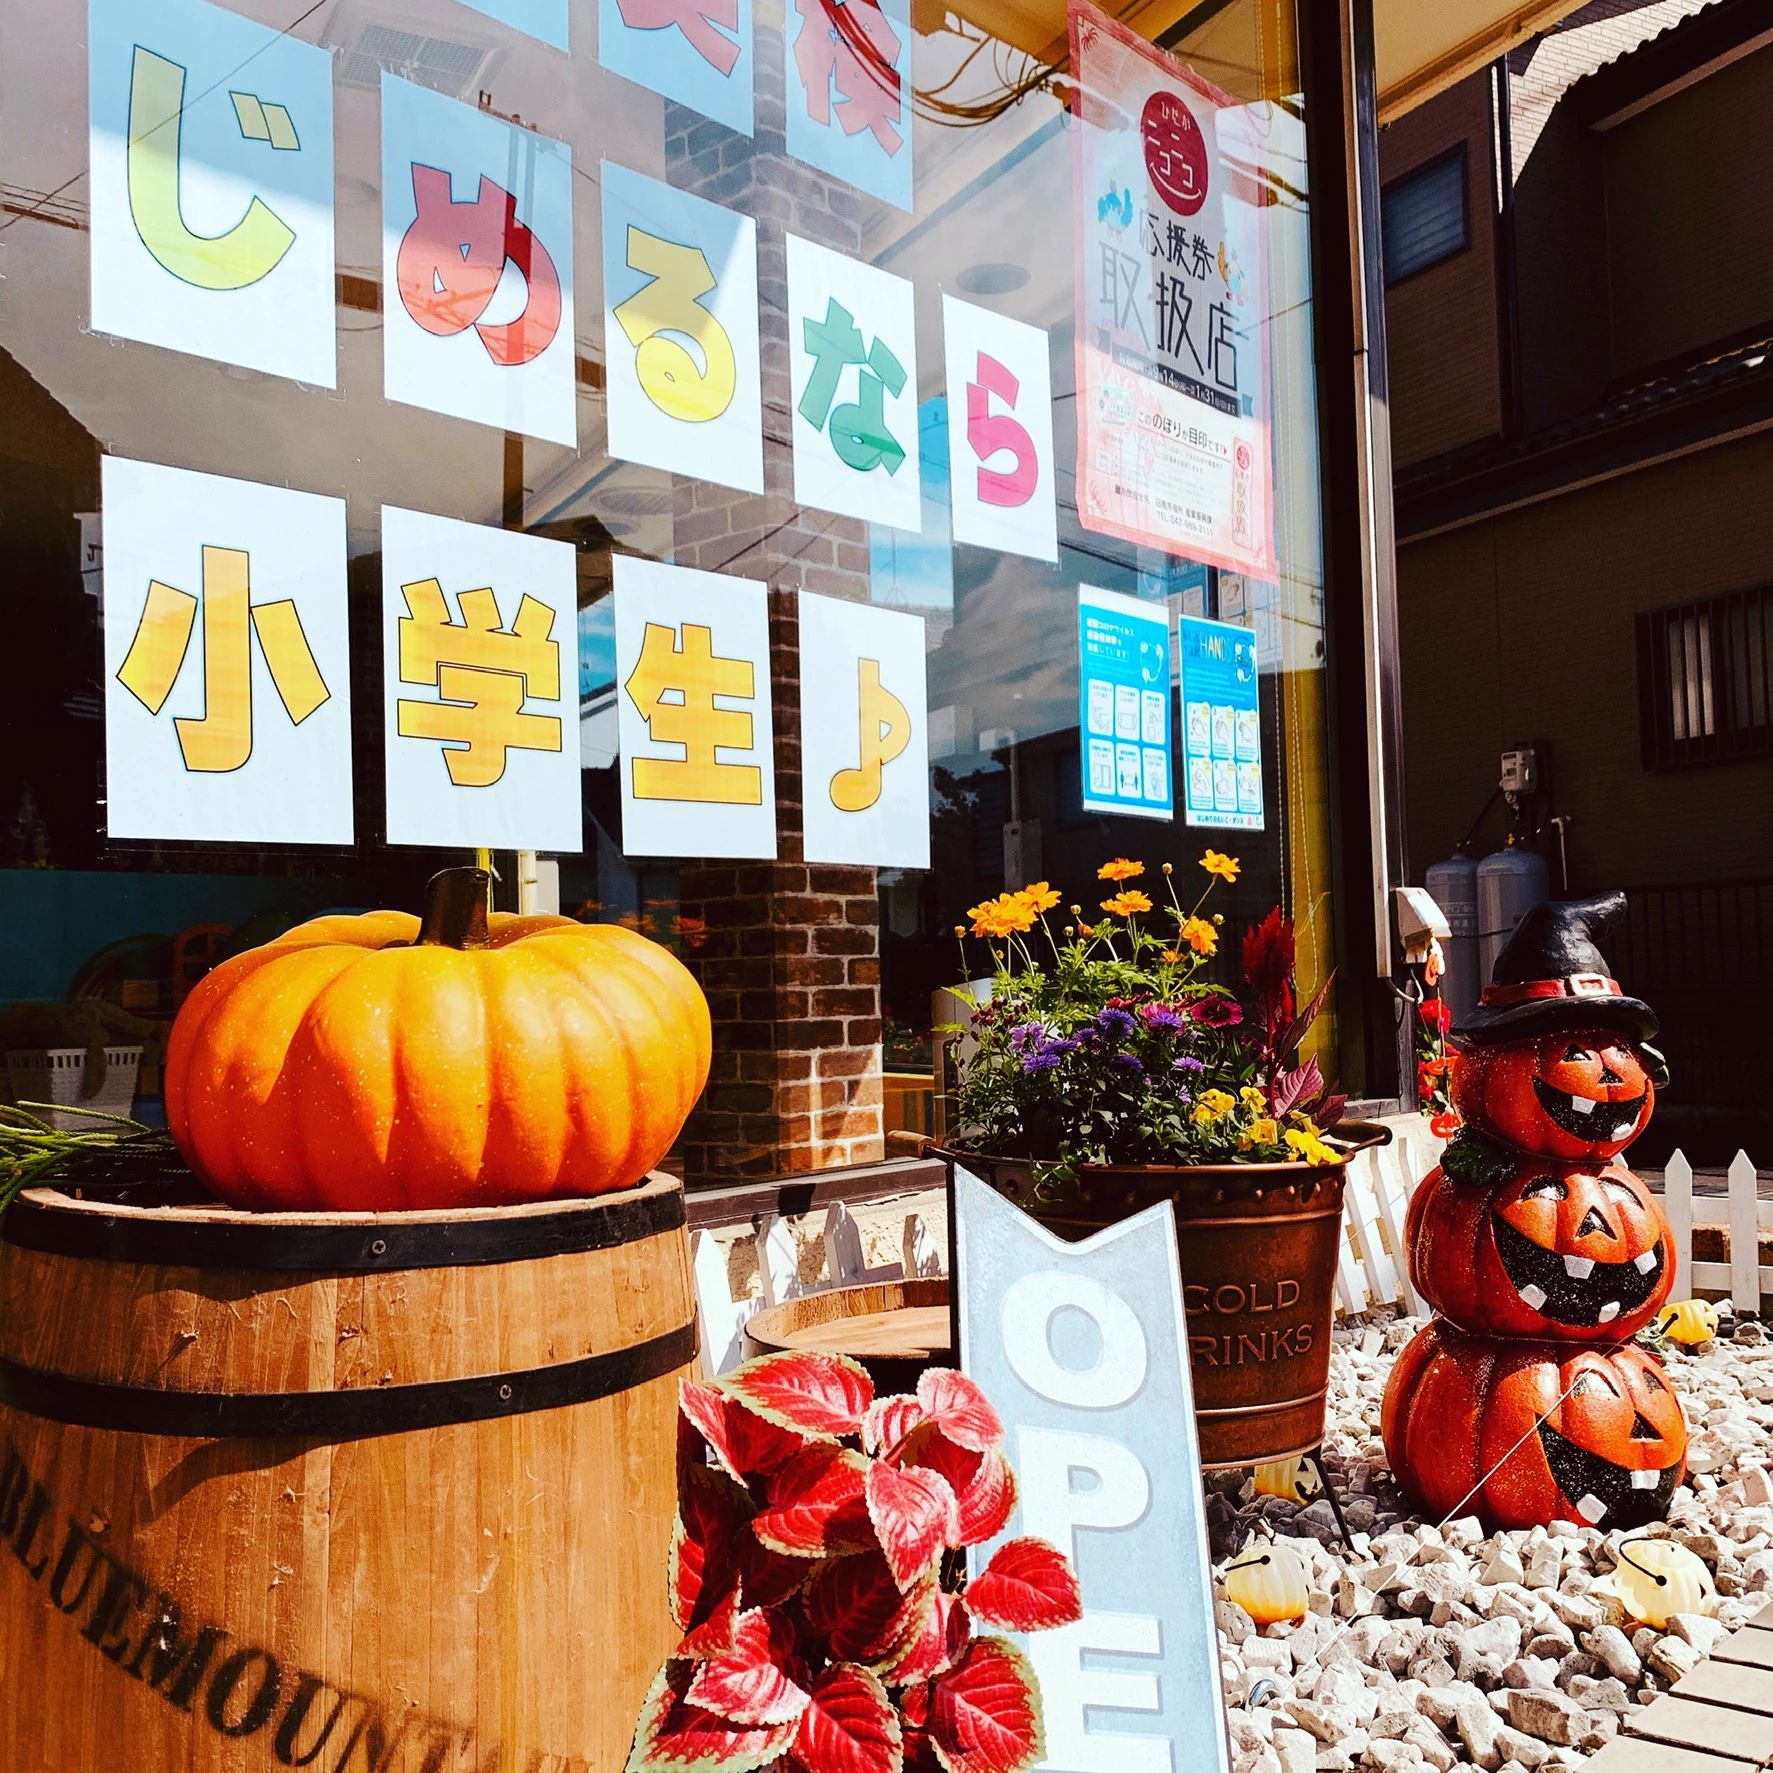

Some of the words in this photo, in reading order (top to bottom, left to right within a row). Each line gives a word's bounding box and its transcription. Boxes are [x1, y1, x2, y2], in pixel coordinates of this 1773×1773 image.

[1139, 208, 1216, 281] 応援券
[1099, 240, 1250, 393] 取扱店
[1184, 1279, 1301, 1316] COLD
[1189, 1323, 1313, 1367] RINKS
